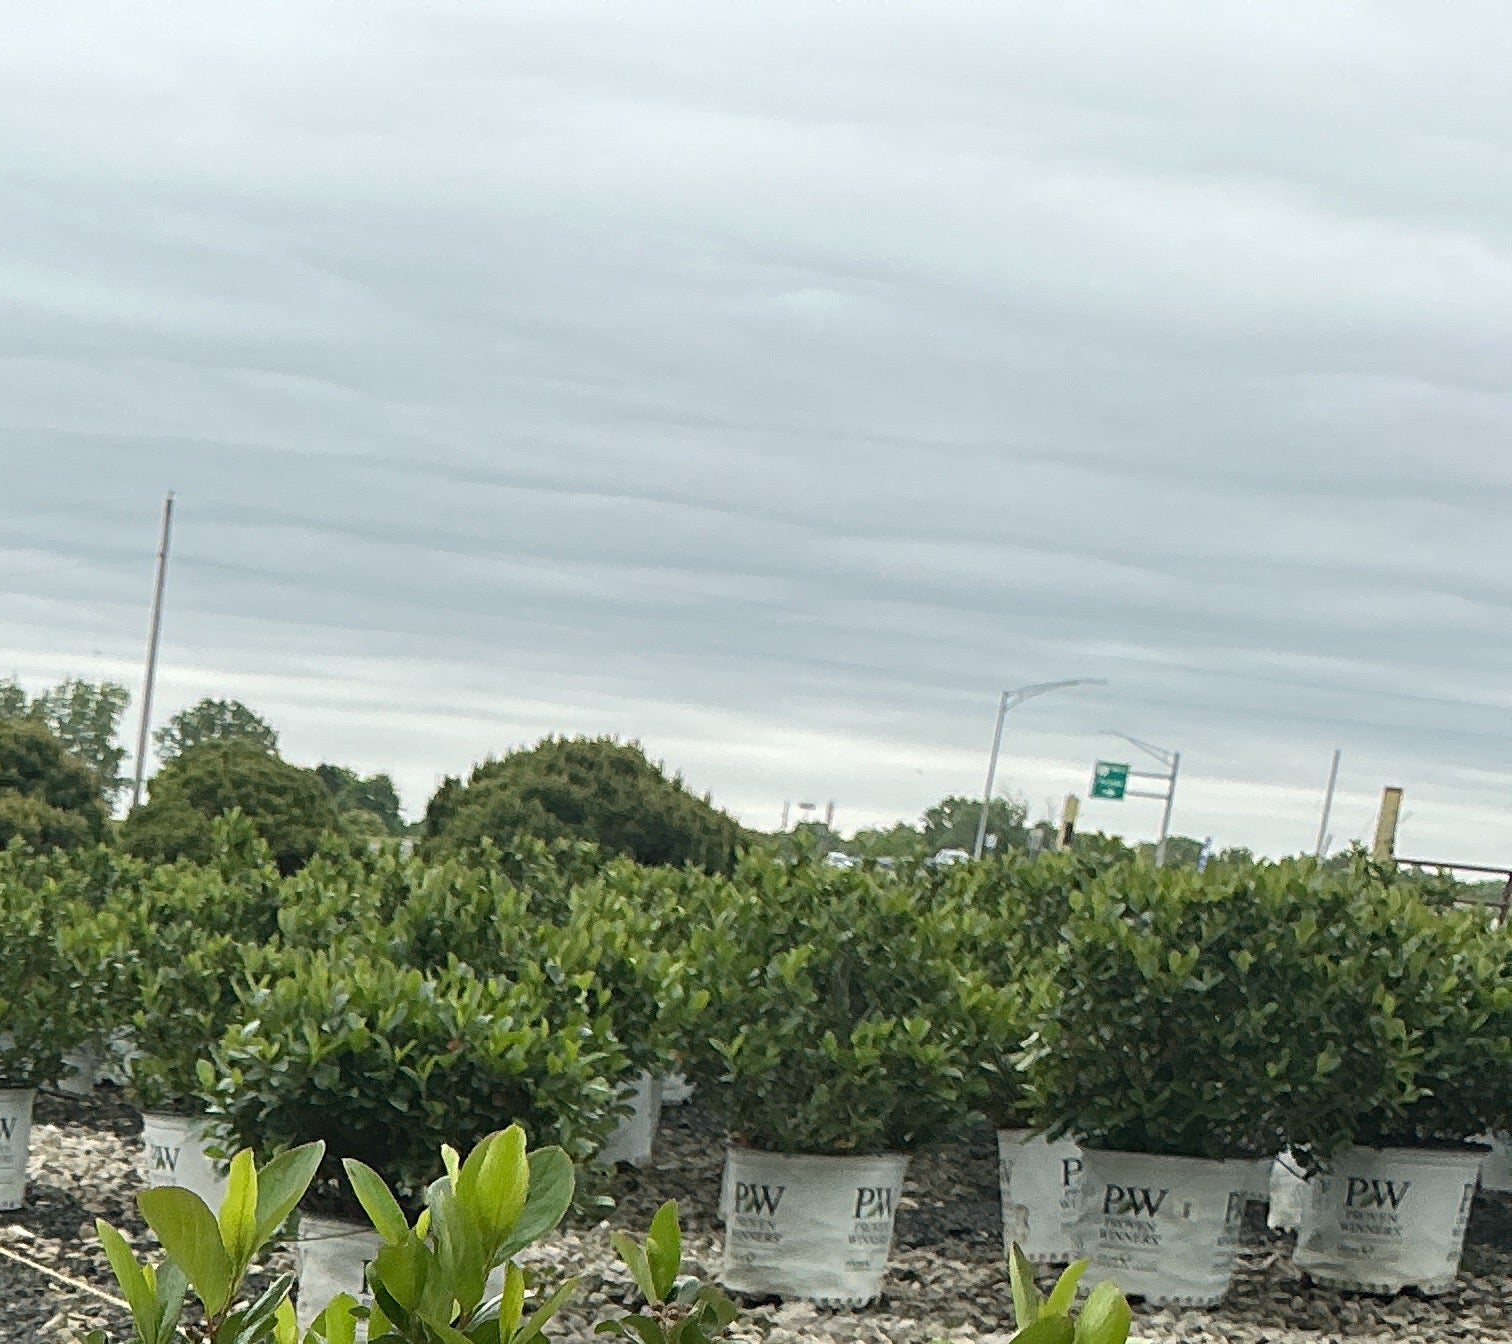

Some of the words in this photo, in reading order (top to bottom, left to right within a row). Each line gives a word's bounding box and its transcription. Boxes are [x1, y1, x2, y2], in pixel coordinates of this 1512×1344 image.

[1062, 1159, 1082, 1186] P
[736, 1182, 785, 1216] PW
[1104, 1183, 1169, 1218] PW
[1346, 1177, 1412, 1210] PW
